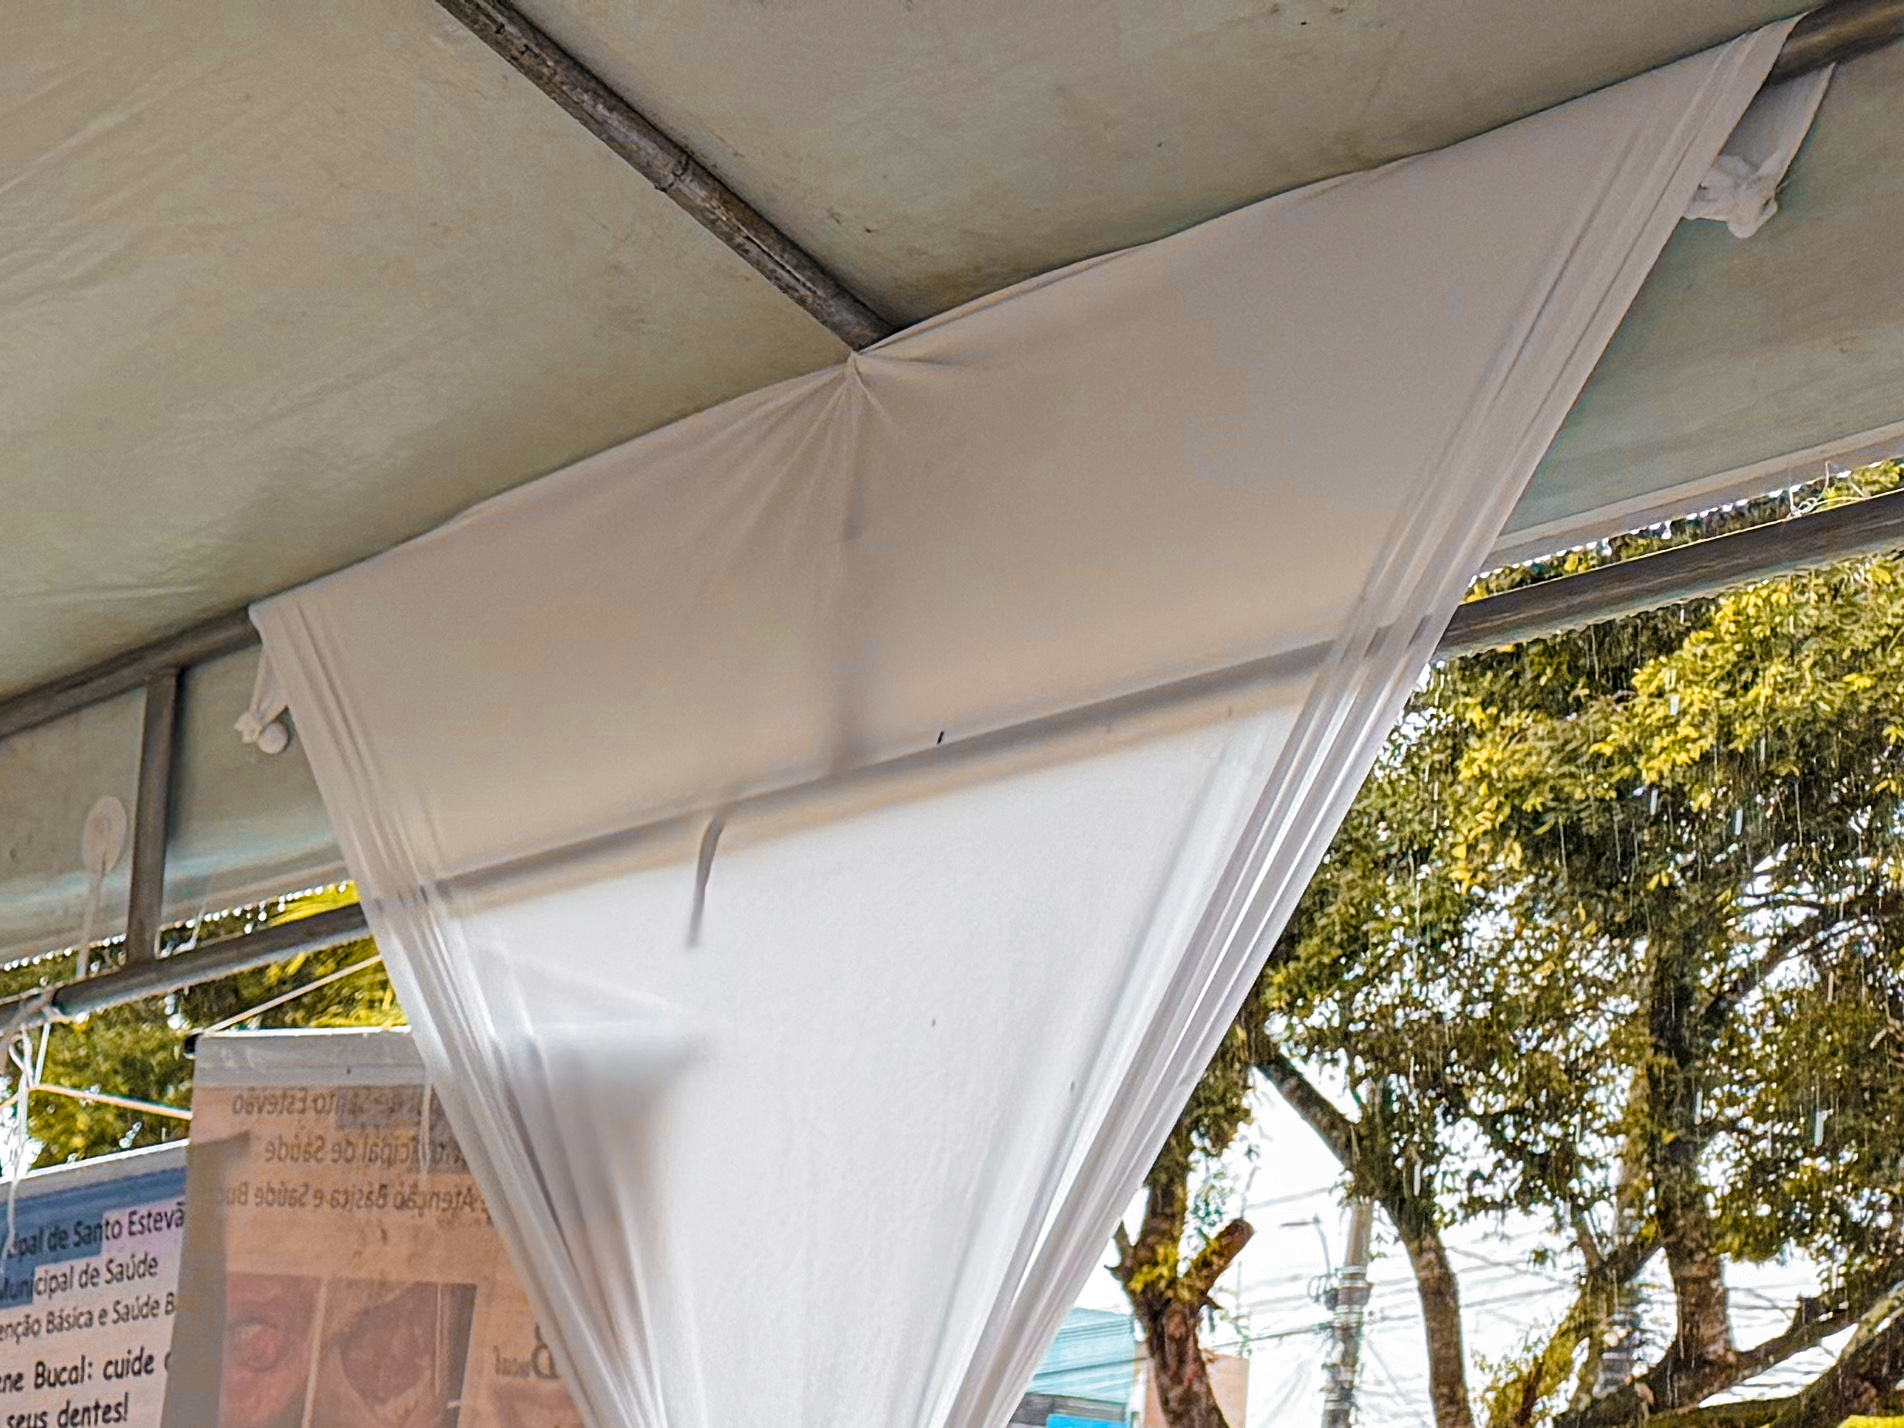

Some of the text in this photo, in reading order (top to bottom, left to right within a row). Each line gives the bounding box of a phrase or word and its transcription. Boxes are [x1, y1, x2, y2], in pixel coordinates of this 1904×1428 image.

[73, 1218, 122, 1248] Santo
[128, 1202, 186, 1236] Estevã
[79, 1263, 100, 1287] de
[105, 1253, 158, 1285] Saúde
[46, 1306, 93, 1334] Básica
[99, 1308, 107, 1326] e
[113, 1294, 160, 1324] Saúde
[34, 1354, 93, 1389] Bucal:
[103, 1346, 154, 1381] cuide
[57, 1392, 129, 1428] dentes!
